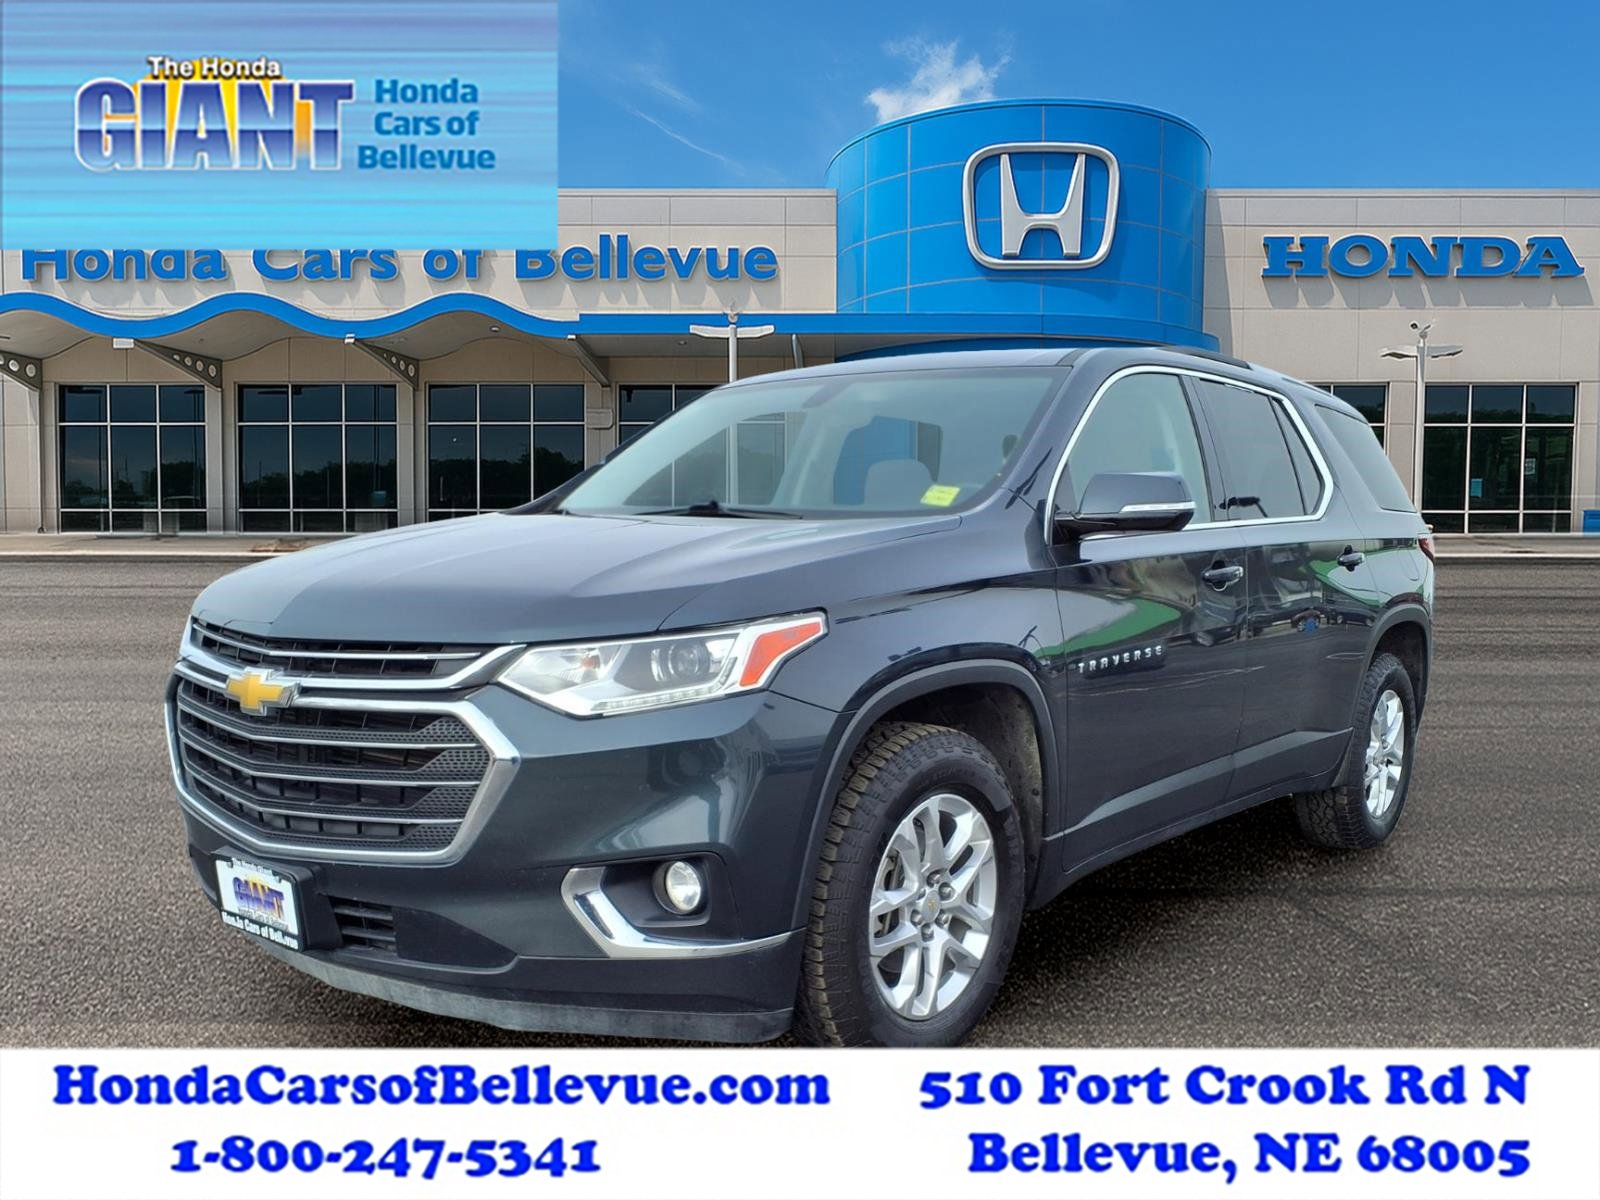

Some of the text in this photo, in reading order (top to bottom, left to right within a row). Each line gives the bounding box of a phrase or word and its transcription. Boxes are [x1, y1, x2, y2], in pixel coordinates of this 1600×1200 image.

[21, 233, 778, 282] Honda Cars of Bellevue
[1262, 234, 1585, 277] HONDA
[1078, 645, 1163, 673] TRAVERSE
[233, 876, 285, 920] GIANT
